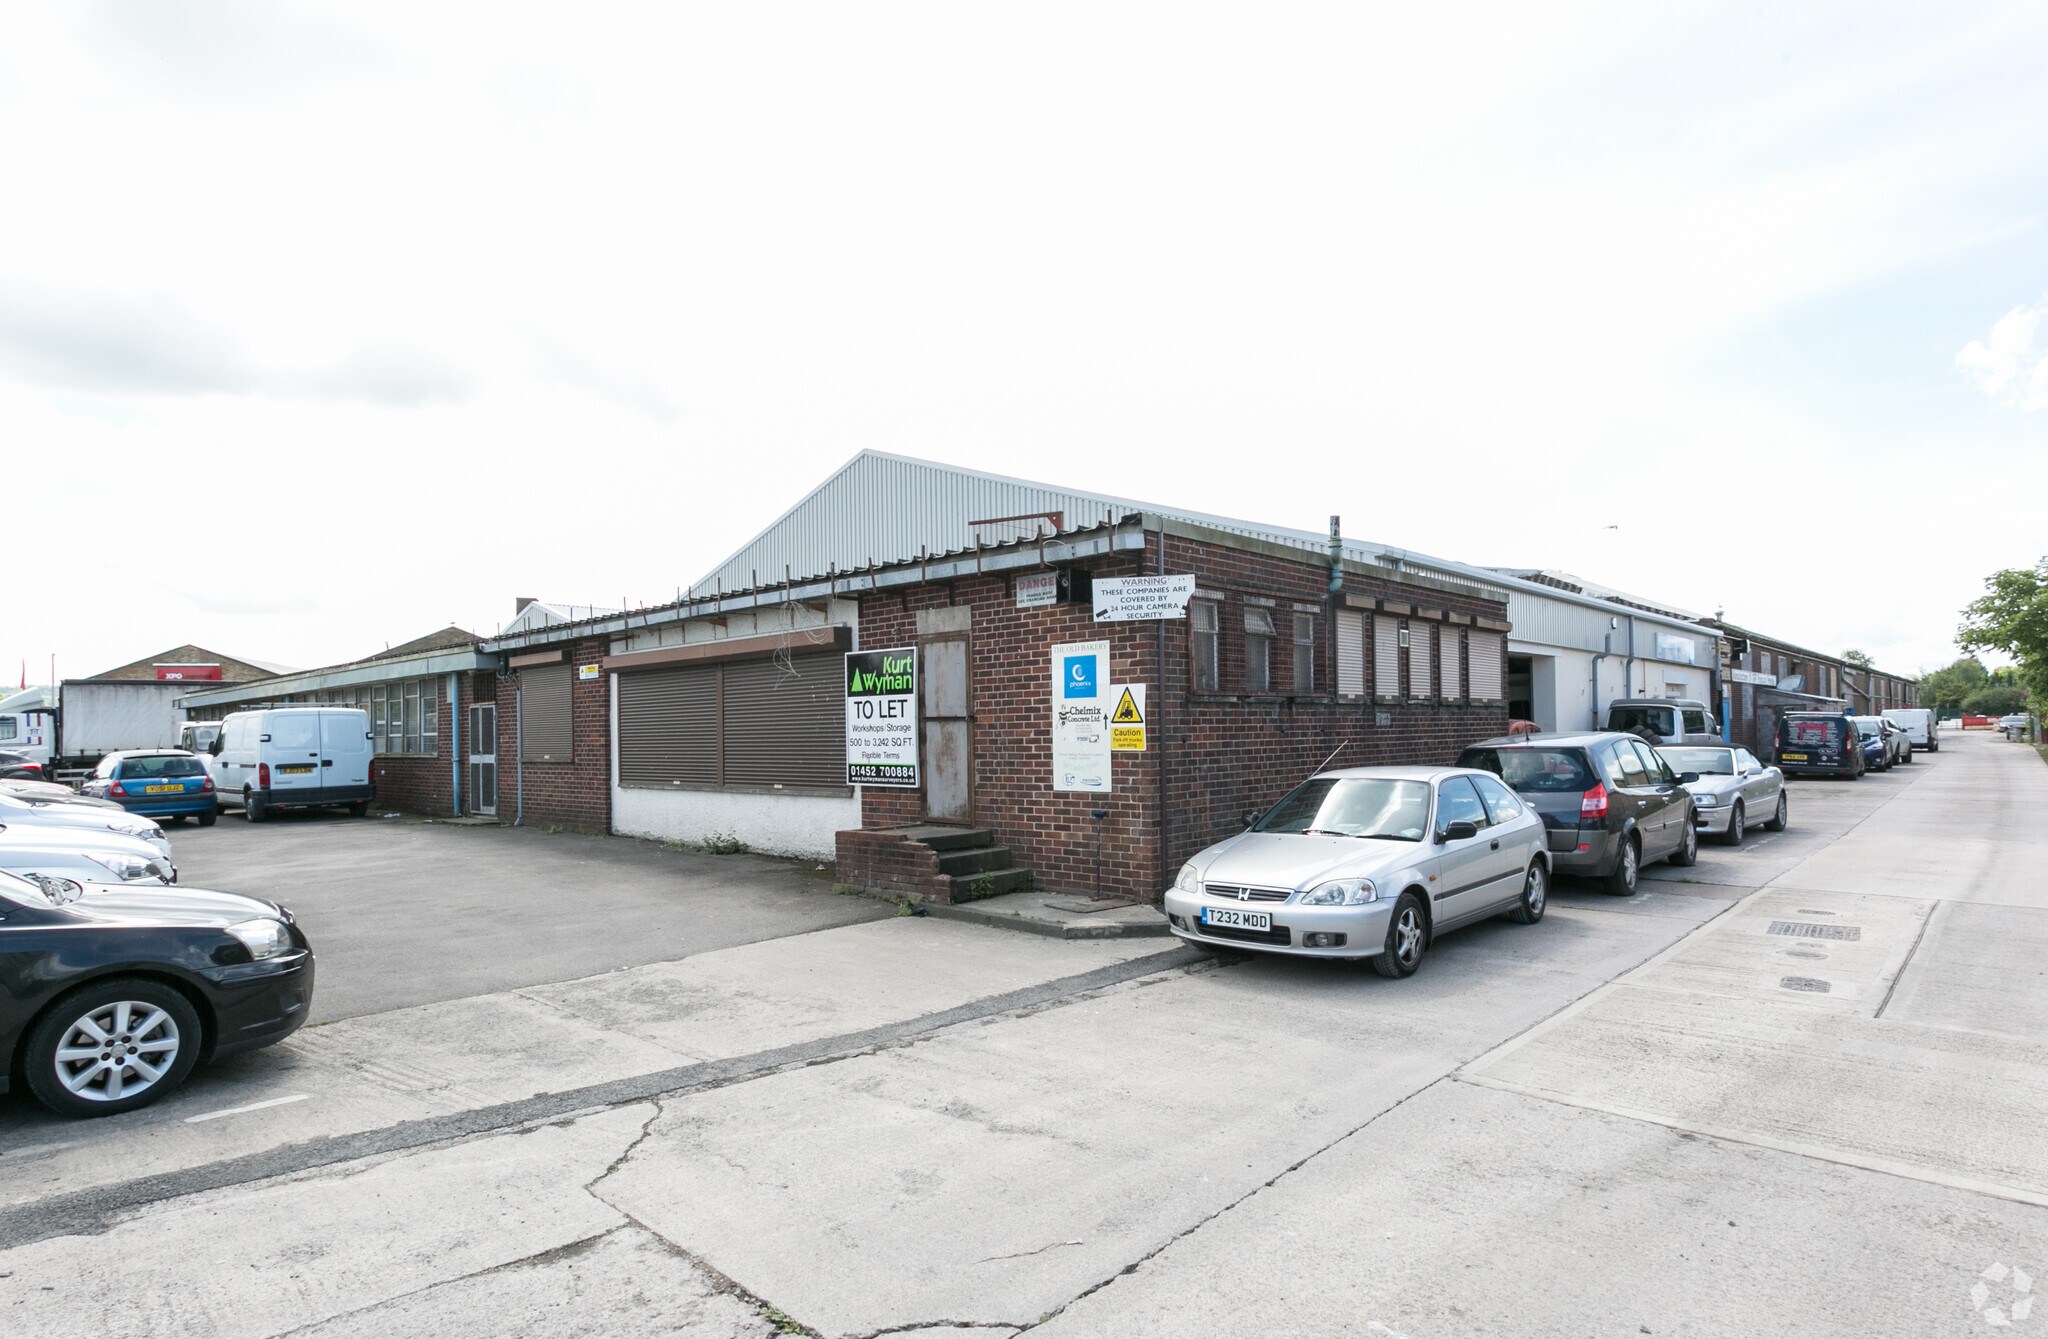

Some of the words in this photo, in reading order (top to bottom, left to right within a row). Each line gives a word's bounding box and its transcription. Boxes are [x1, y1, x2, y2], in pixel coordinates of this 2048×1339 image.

[1018, 577, 1055, 590] DANGE
[1121, 577, 1167, 586] WARNING
[1126, 586, 1170, 595] COMPANIES
[1121, 603, 1144, 611] HOUR
[1126, 611, 1163, 619] SECURITY
[1080, 642, 1107, 651] BAKERY
[883, 656, 912, 674] Kurt
[862, 673, 912, 695] Wyman
[854, 700, 874, 719] TO
[879, 699, 908, 718] LET
[1070, 706, 1101, 715] Chelmix
[852, 724, 884, 733] Workshops
[886, 723, 912, 733] Storage
[1113, 728, 1141, 737] Caution
[850, 738, 863, 747] 500
[864, 738, 871, 747] to
[873, 737, 889, 747] 3,242
[862, 751, 881, 759] Flexible
[883, 751, 900, 759] Terms
[850, 765, 877, 776] 01452
[879, 766, 914, 777] 700884
[1208, 909, 1240, 925] T232
[1242, 913, 1267, 928] MDD
